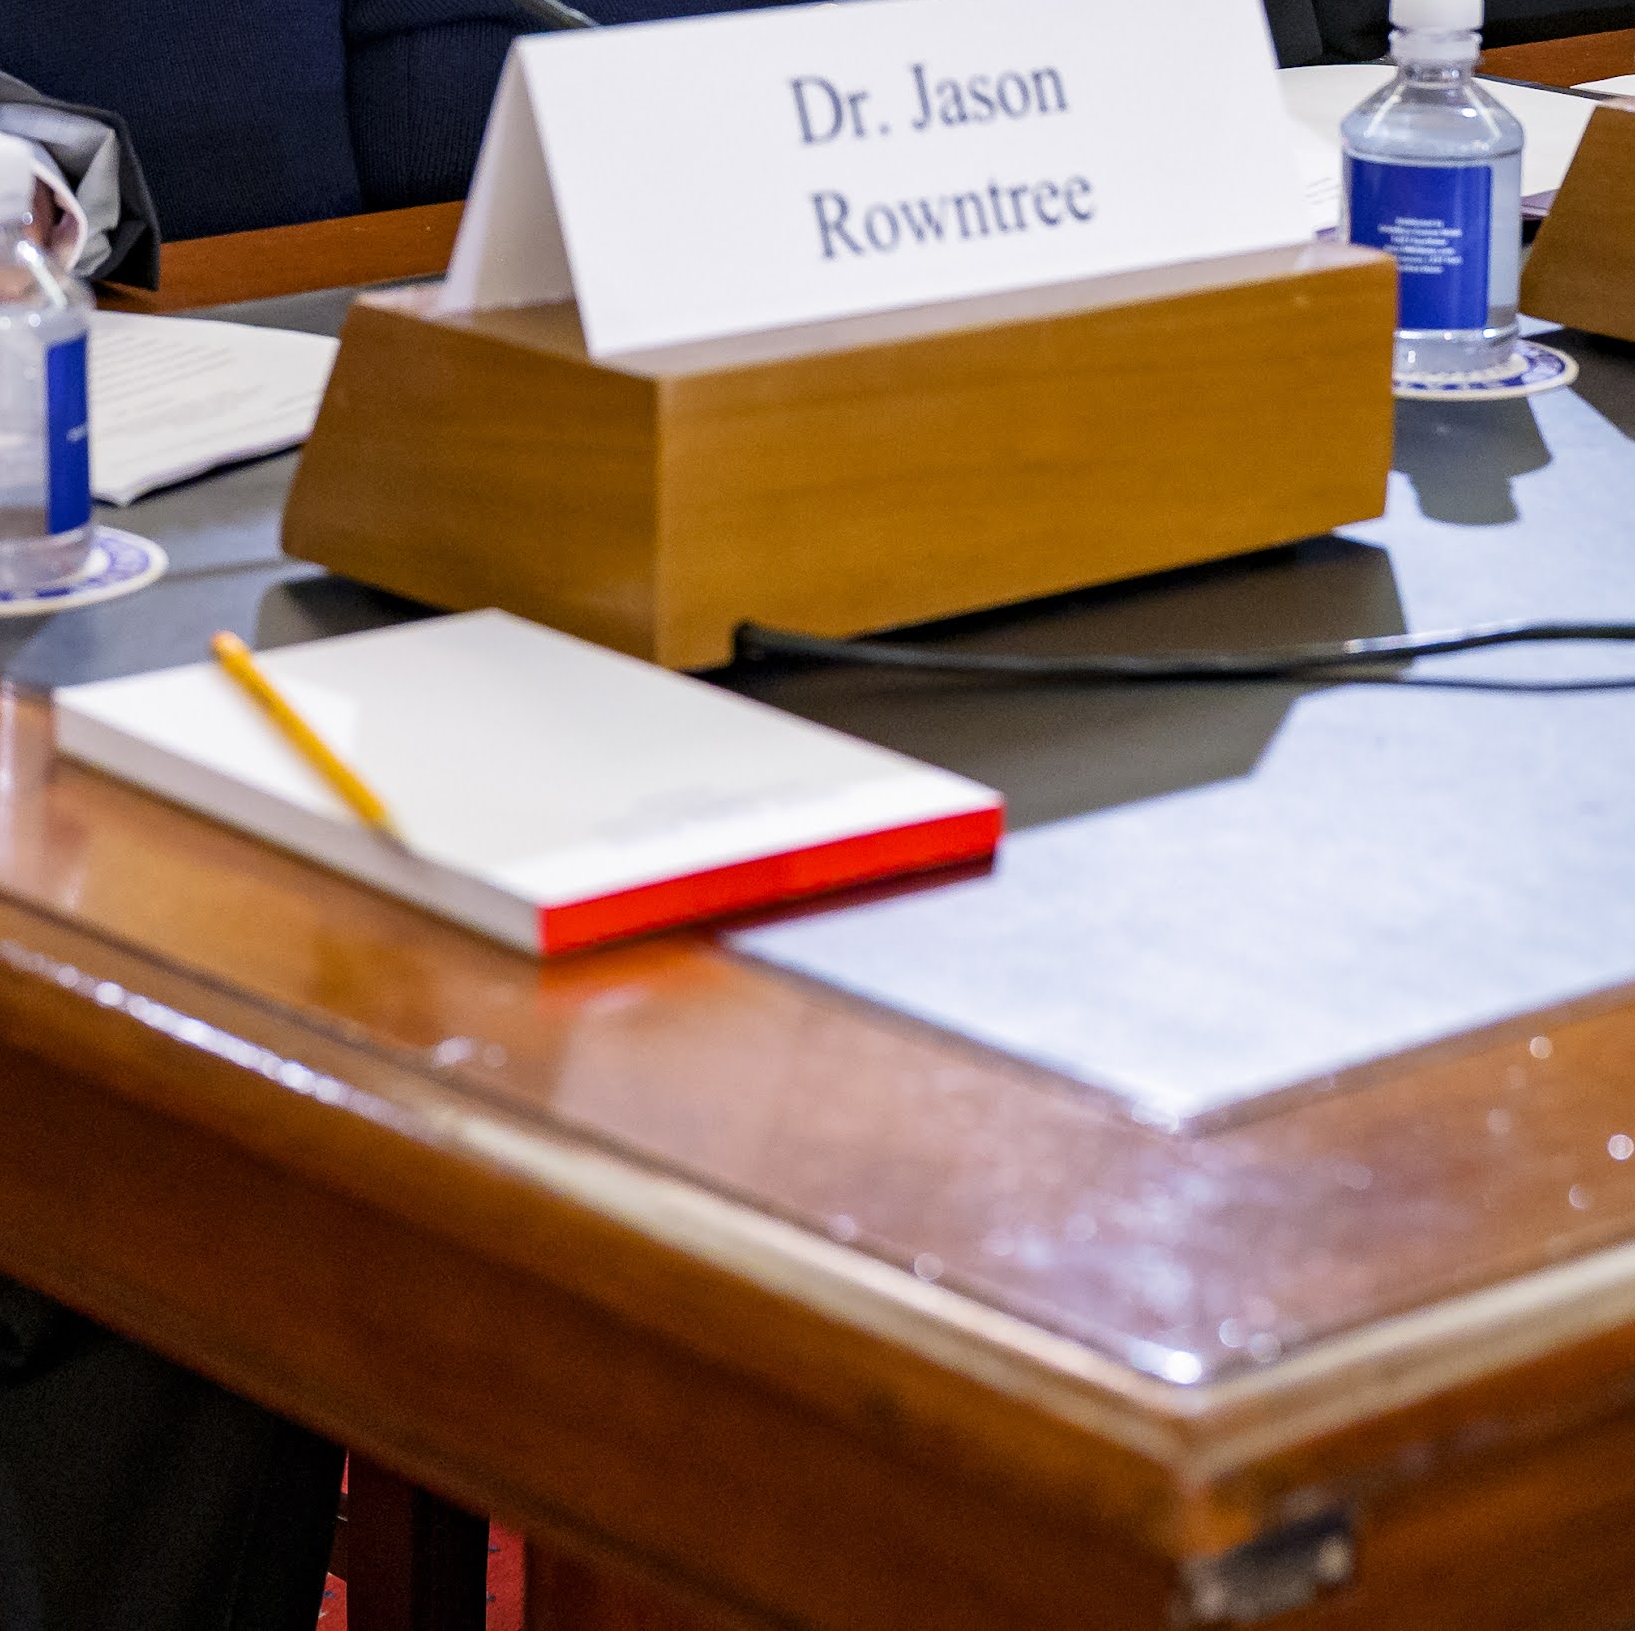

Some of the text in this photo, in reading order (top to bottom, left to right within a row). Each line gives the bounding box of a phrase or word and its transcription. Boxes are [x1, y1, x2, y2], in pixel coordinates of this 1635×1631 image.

[788, 62, 1069, 146] Dr. Jason
[808, 172, 1095, 261] Rowntree
